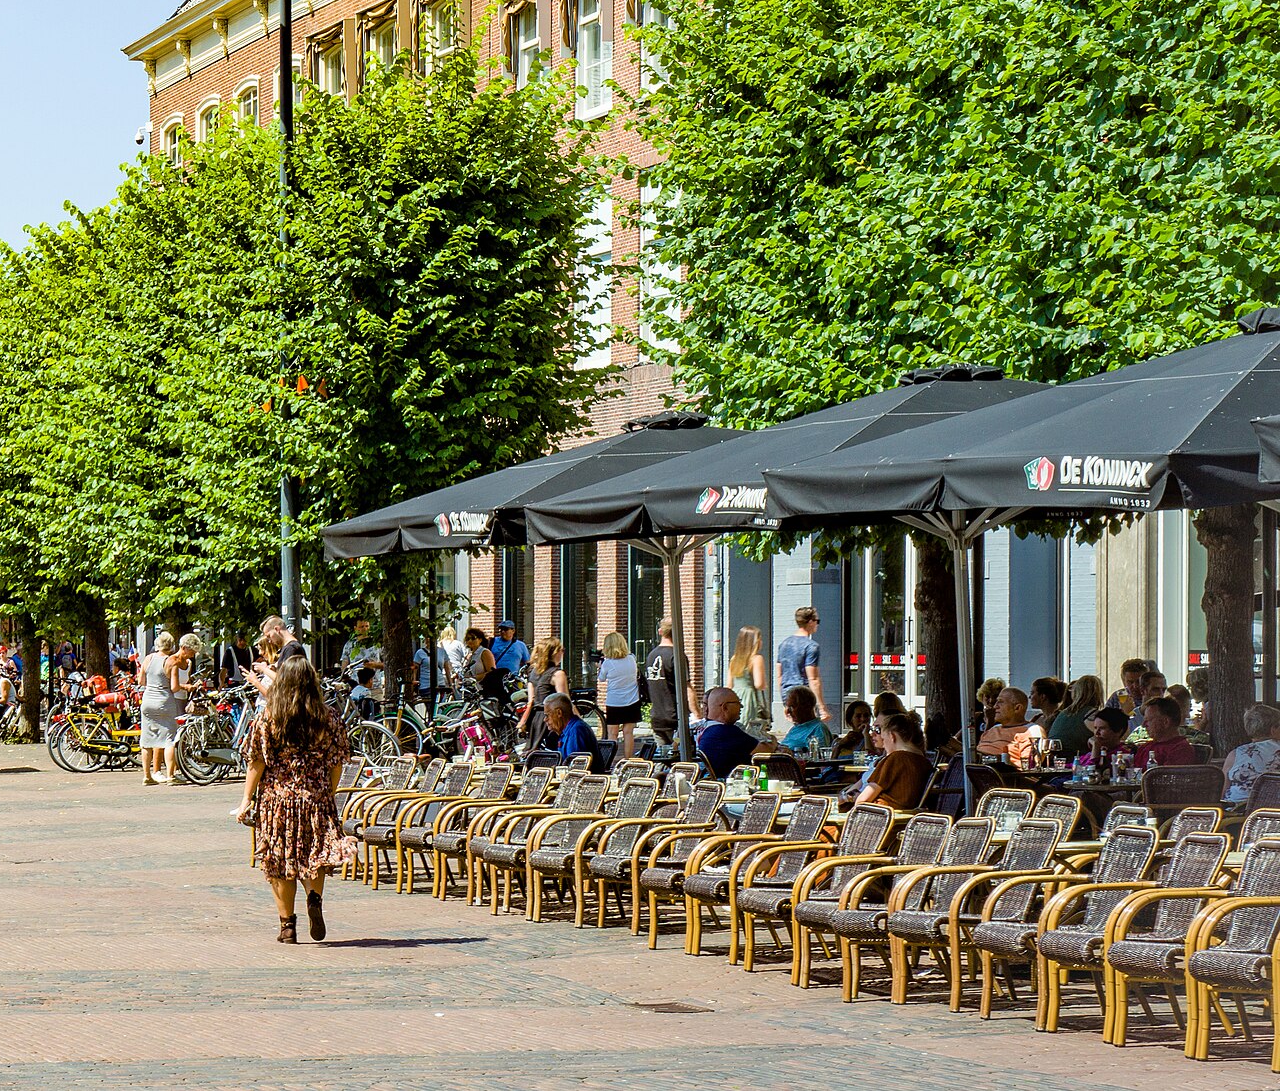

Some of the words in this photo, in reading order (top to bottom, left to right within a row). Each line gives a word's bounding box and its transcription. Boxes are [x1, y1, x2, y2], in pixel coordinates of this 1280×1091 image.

[1060, 455, 1082, 485] DE
[1082, 455, 1153, 488] KONINCK
[1109, 496, 1129, 507] ANNO
